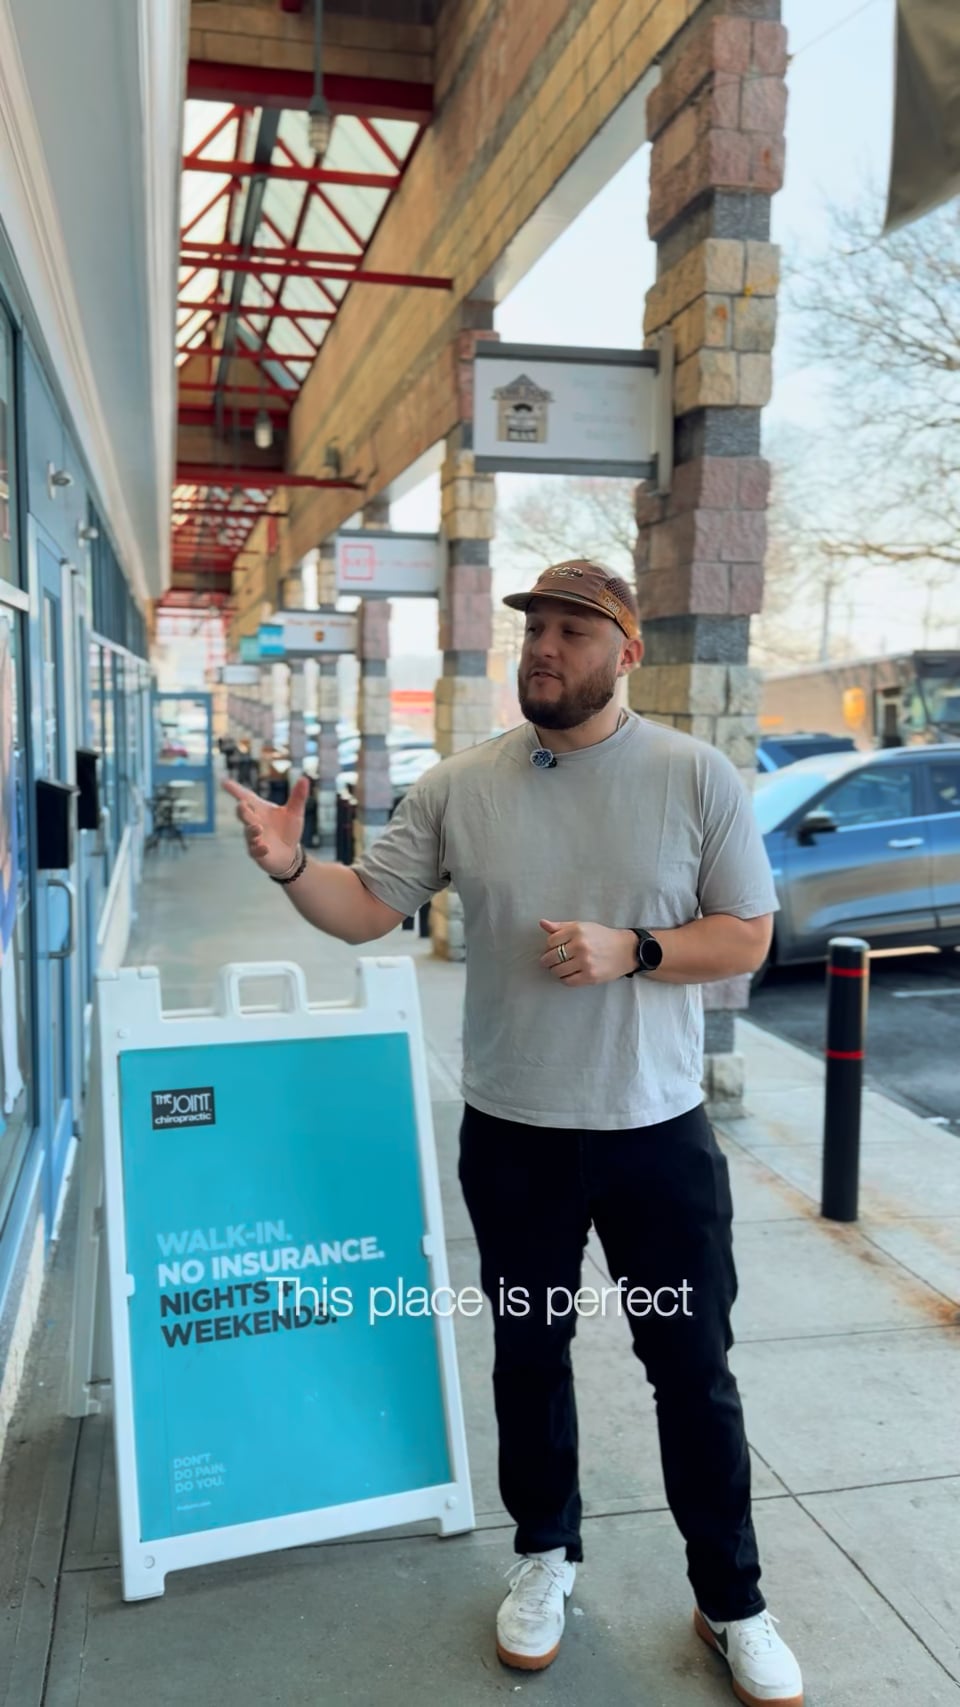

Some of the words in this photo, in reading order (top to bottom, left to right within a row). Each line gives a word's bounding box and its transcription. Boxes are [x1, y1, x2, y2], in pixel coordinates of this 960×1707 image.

[154, 1093, 172, 1105] THE
[170, 1093, 211, 1114] JOINT
[154, 1112, 213, 1124] chiropractic
[156, 1219, 293, 1257] WALK-IN.
[158, 1259, 205, 1287] NO
[211, 1236, 386, 1280] INSURANCE.
[159, 1280, 271, 1318] NIGHTS
[160, 1301, 339, 1349] WEEKENDS.
[174, 1469, 193, 1481] DO
[175, 1481, 194, 1493] DO
